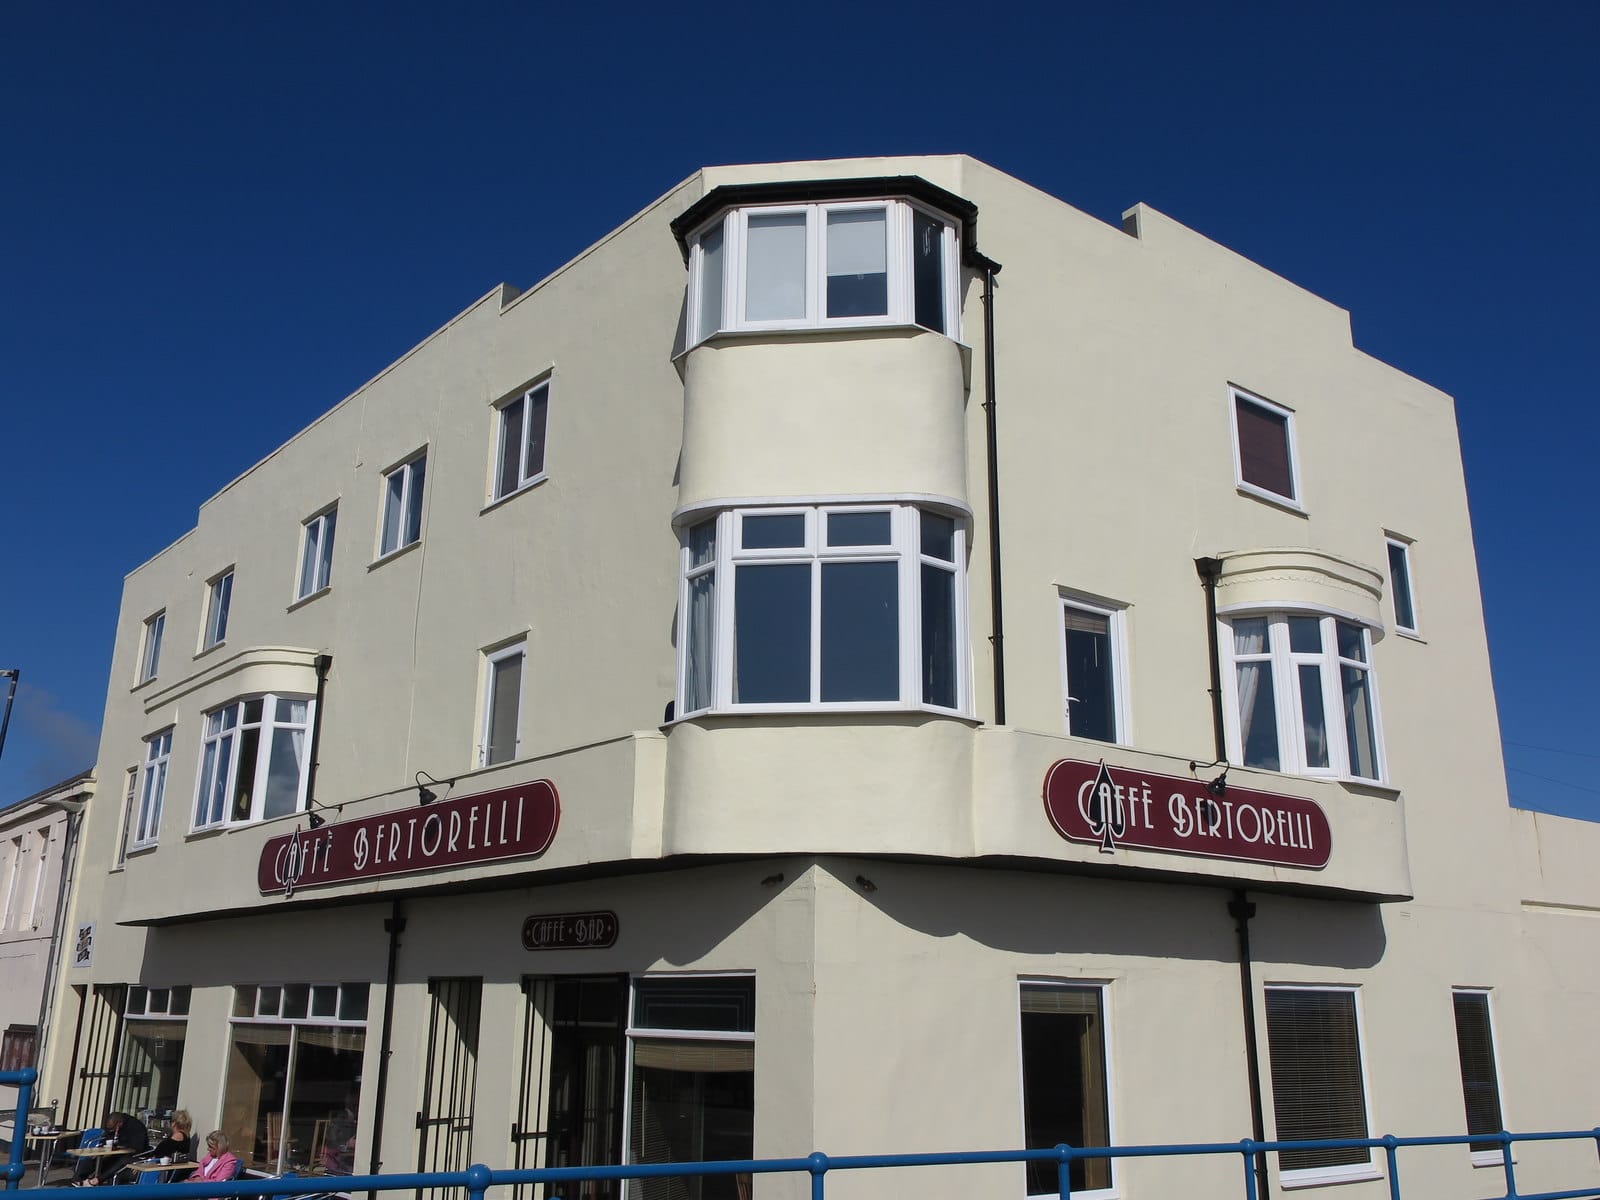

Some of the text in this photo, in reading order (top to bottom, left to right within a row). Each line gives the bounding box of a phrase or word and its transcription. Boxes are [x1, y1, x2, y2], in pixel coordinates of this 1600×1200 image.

[353, 797, 524, 871] BERTORELLI
[1168, 793, 1313, 850] BERTORELLI
[575, 919, 604, 943] BAR
